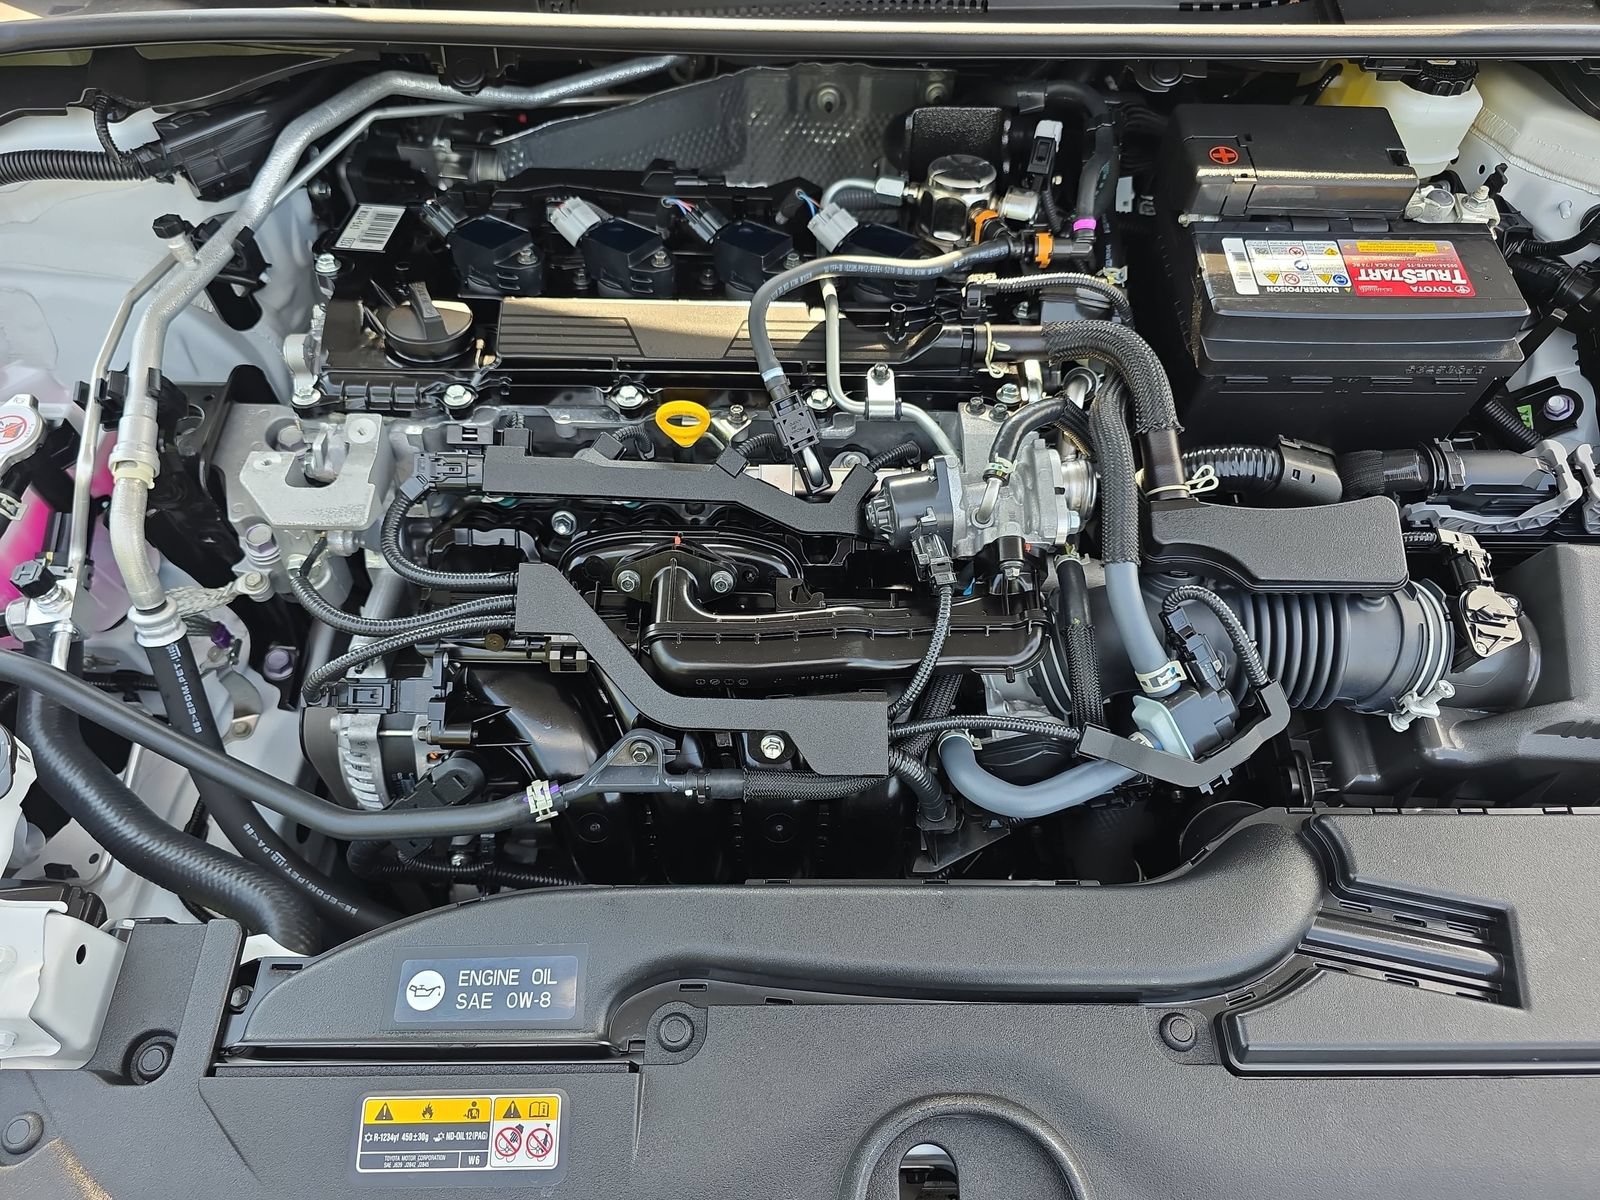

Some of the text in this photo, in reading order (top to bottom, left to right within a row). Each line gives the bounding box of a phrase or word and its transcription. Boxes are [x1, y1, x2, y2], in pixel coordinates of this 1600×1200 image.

[1410, 285, 1455, 293] TOYOTA
[15, 565, 39, 581] H
[458, 968, 558, 987] ENGINE OIL
[455, 991, 552, 1010] SAE 0W-8
[373, 1132, 399, 1144] R-1234yf
[401, 1132, 429, 1143] 450±30g
[468, 1155, 480, 1165] W6
